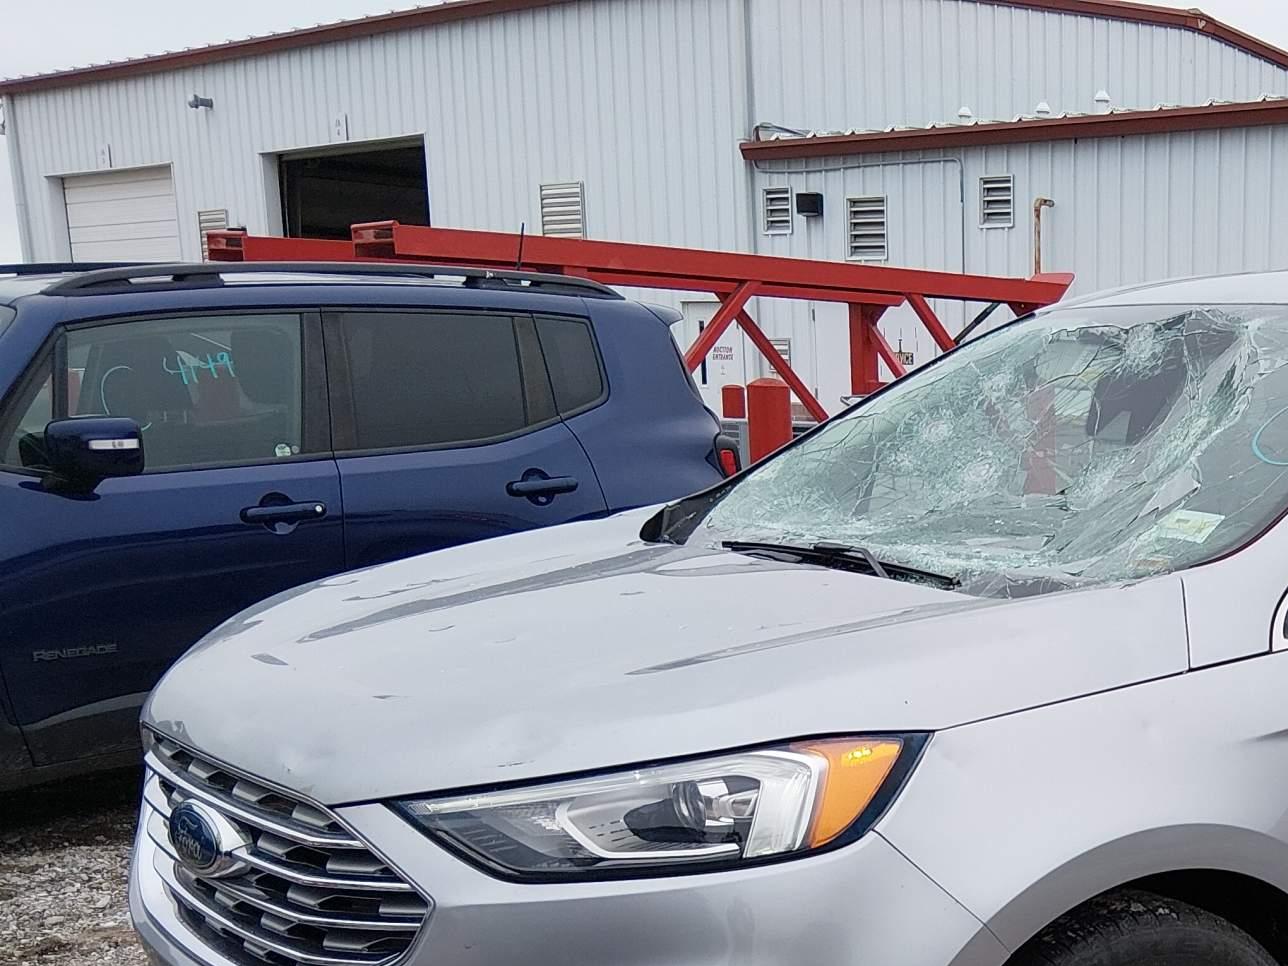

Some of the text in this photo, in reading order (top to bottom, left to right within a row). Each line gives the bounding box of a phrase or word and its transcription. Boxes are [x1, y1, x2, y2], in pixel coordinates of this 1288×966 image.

[712, 353, 734, 361] ENTRANCE
[32, 643, 119, 662] RENEGADE
[176, 815, 202, 861] Ford
